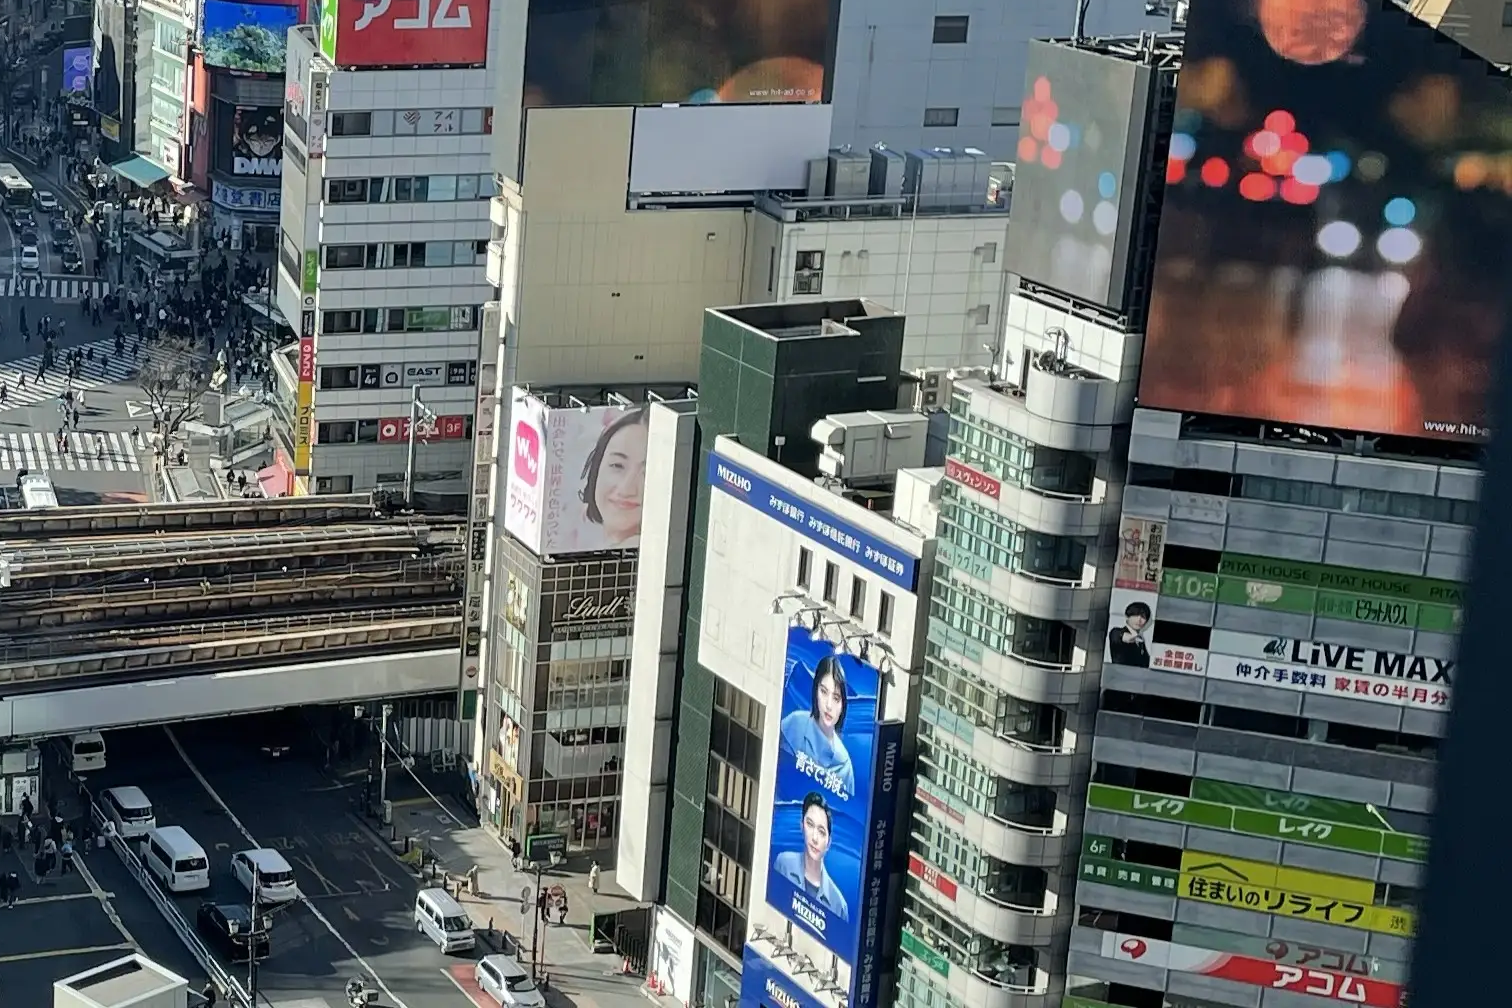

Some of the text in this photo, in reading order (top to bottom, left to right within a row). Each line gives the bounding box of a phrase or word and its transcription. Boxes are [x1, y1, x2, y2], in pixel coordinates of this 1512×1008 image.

[299, 406, 310, 445] プロミス
[446, 423, 461, 433] 3F
[717, 463, 752, 493] MIZUHO
[769, 493, 805, 524] みずほ銀行
[1221, 559, 1258, 574] PITAT
[1262, 564, 1311, 581] HOUSE
[1320, 572, 1357, 586] PITAT
[1361, 577, 1413, 594] HOUSE
[1236, 662, 1450, 706] 仲介手数料 家賃の半月分
[1373, 650, 1455, 685] MAX
[882, 741, 897, 793] MIZUHO
[1132, 793, 1185, 815] レイク
[1278, 818, 1333, 840] レイク
[1089, 840, 1107, 854] 6F
[791, 896, 826, 932] MIZUHO
[1188, 876, 1365, 924] 住まいのリライフ
[1295, 945, 1371, 975] アコム
[1272, 964, 1367, 1003] アコム
